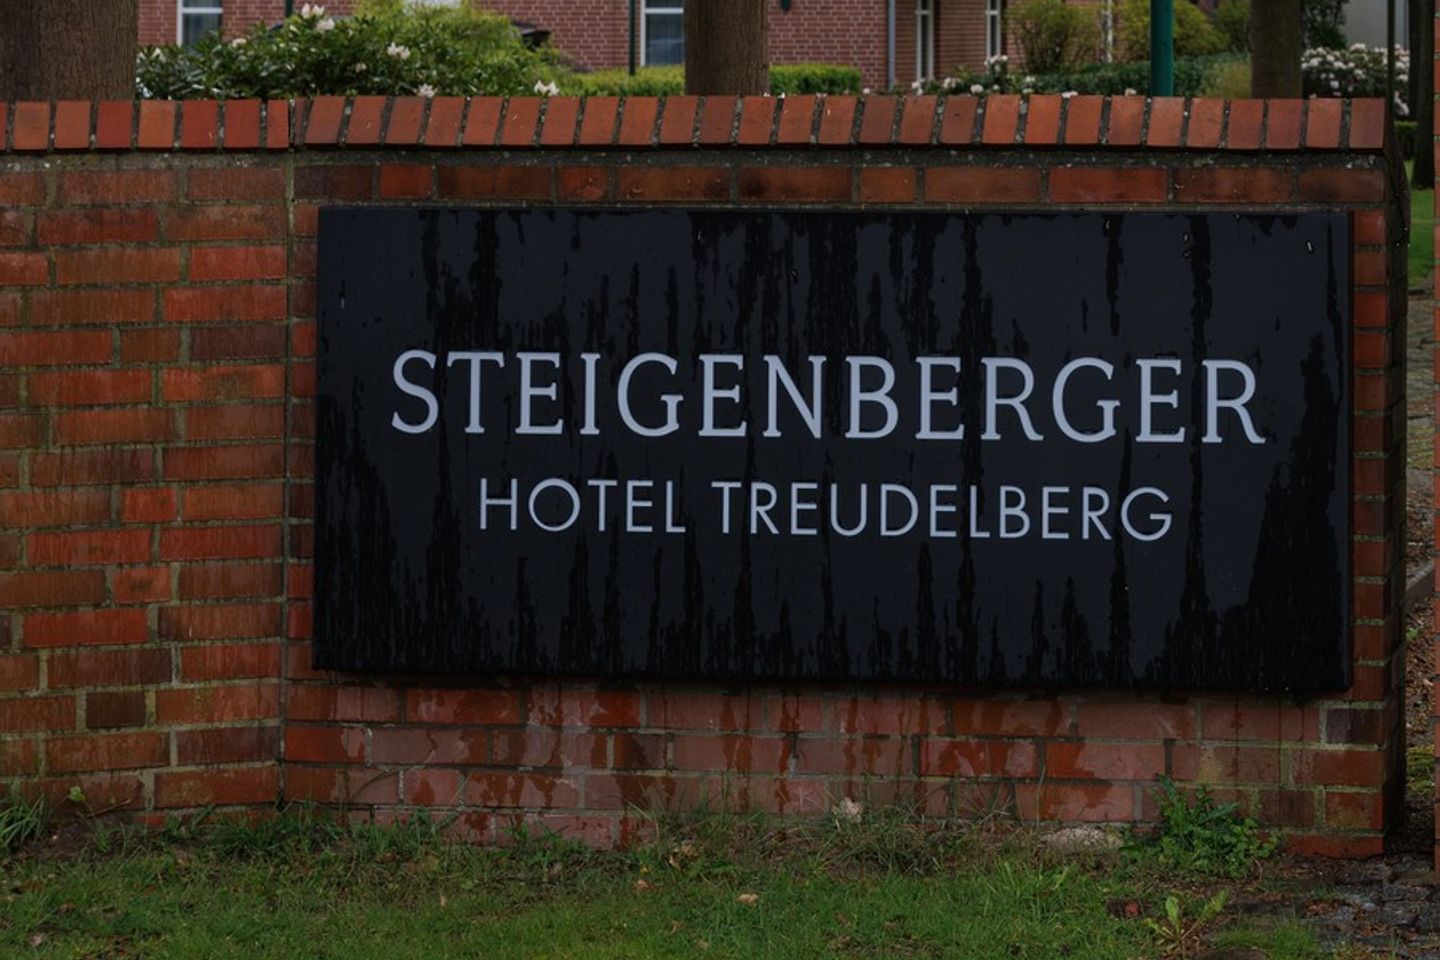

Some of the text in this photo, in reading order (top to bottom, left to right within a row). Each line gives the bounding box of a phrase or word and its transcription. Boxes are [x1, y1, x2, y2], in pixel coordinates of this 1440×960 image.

[391, 349, 1267, 444] STEIGENBERGER
[478, 476, 1173, 543] HOTEL TREUDELBERG
